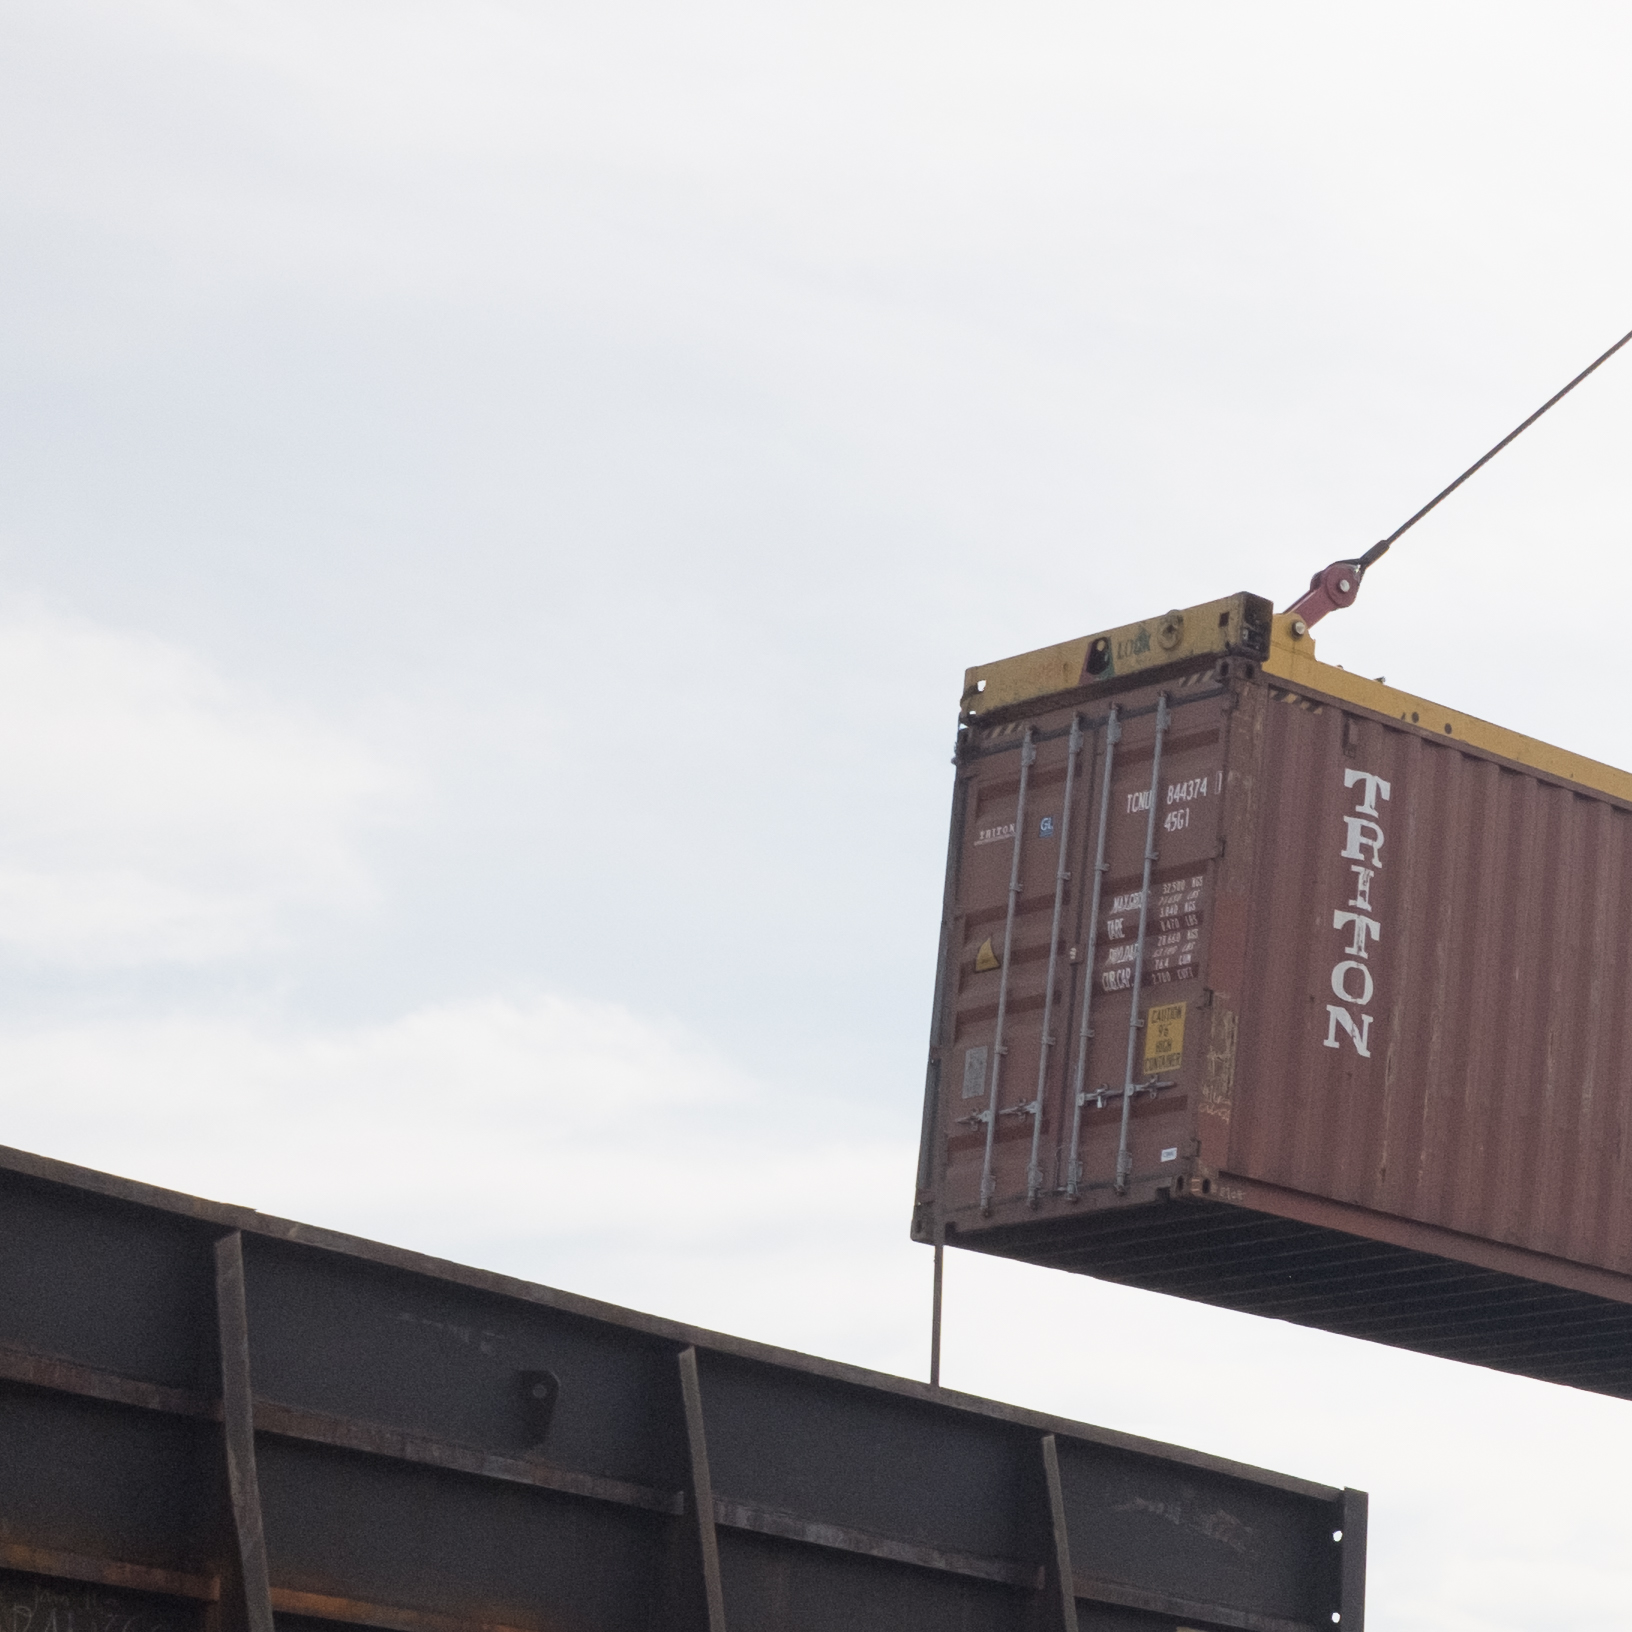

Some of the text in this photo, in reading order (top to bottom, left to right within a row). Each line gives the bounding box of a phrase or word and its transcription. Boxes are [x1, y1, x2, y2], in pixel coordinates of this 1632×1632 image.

[1127, 790, 1153, 813] TCNU
[1167, 777, 1207, 805] 844374
[980, 823, 1015, 839] TRITON
[1164, 808, 1189, 832] 45G1
[1323, 768, 1391, 1058] TRITON
[1151, 1004, 1182, 1024] CAUTION
[1144, 1052, 1181, 1072] CONTAINER
